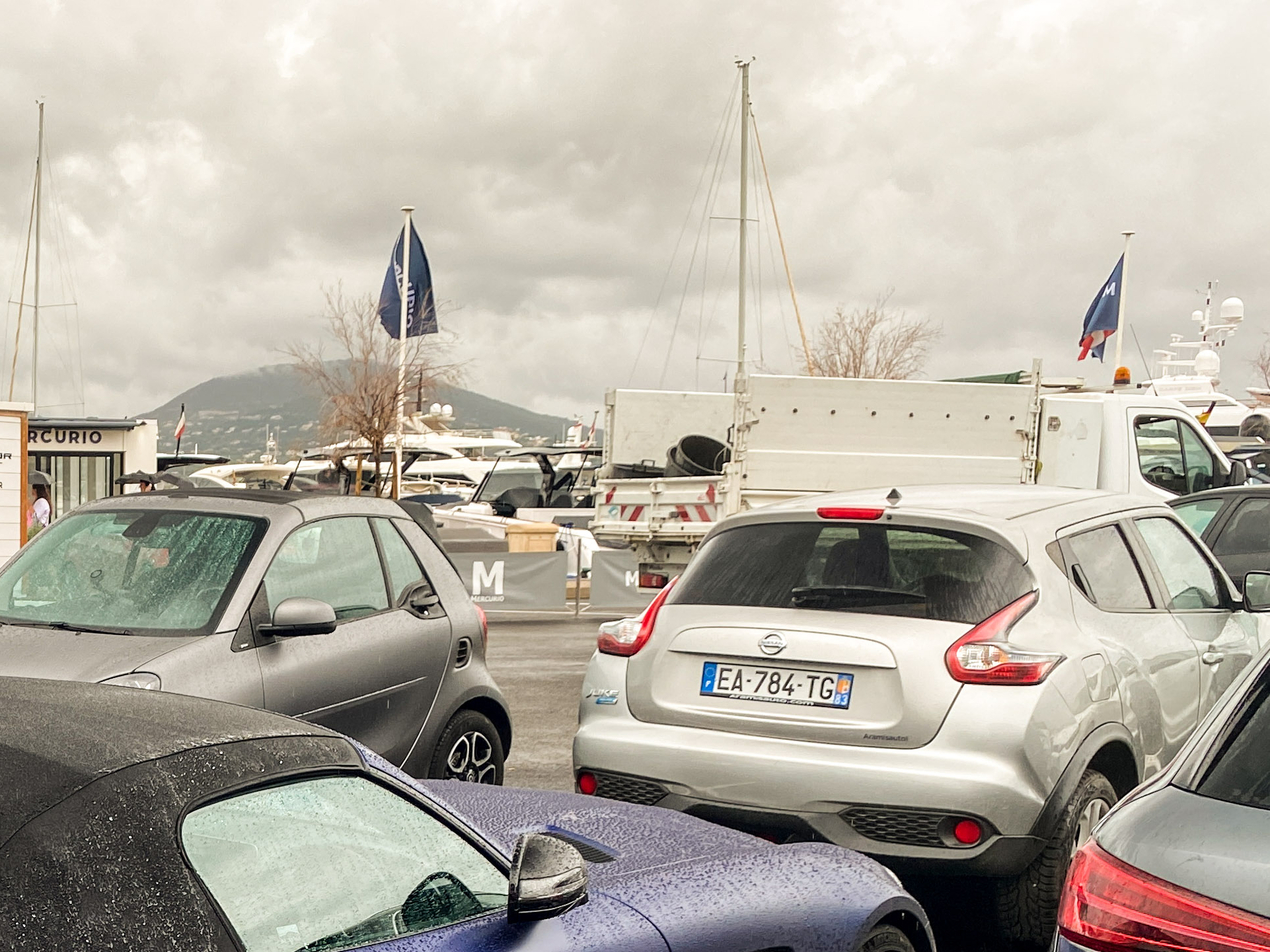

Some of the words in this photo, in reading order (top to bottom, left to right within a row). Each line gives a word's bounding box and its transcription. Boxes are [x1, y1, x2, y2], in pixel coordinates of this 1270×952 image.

[472, 560, 505, 595] M
[586, 688, 619, 699] JUKE
[717, 667, 834, 700] EA-784-TG
[833, 694, 848, 705] 83
